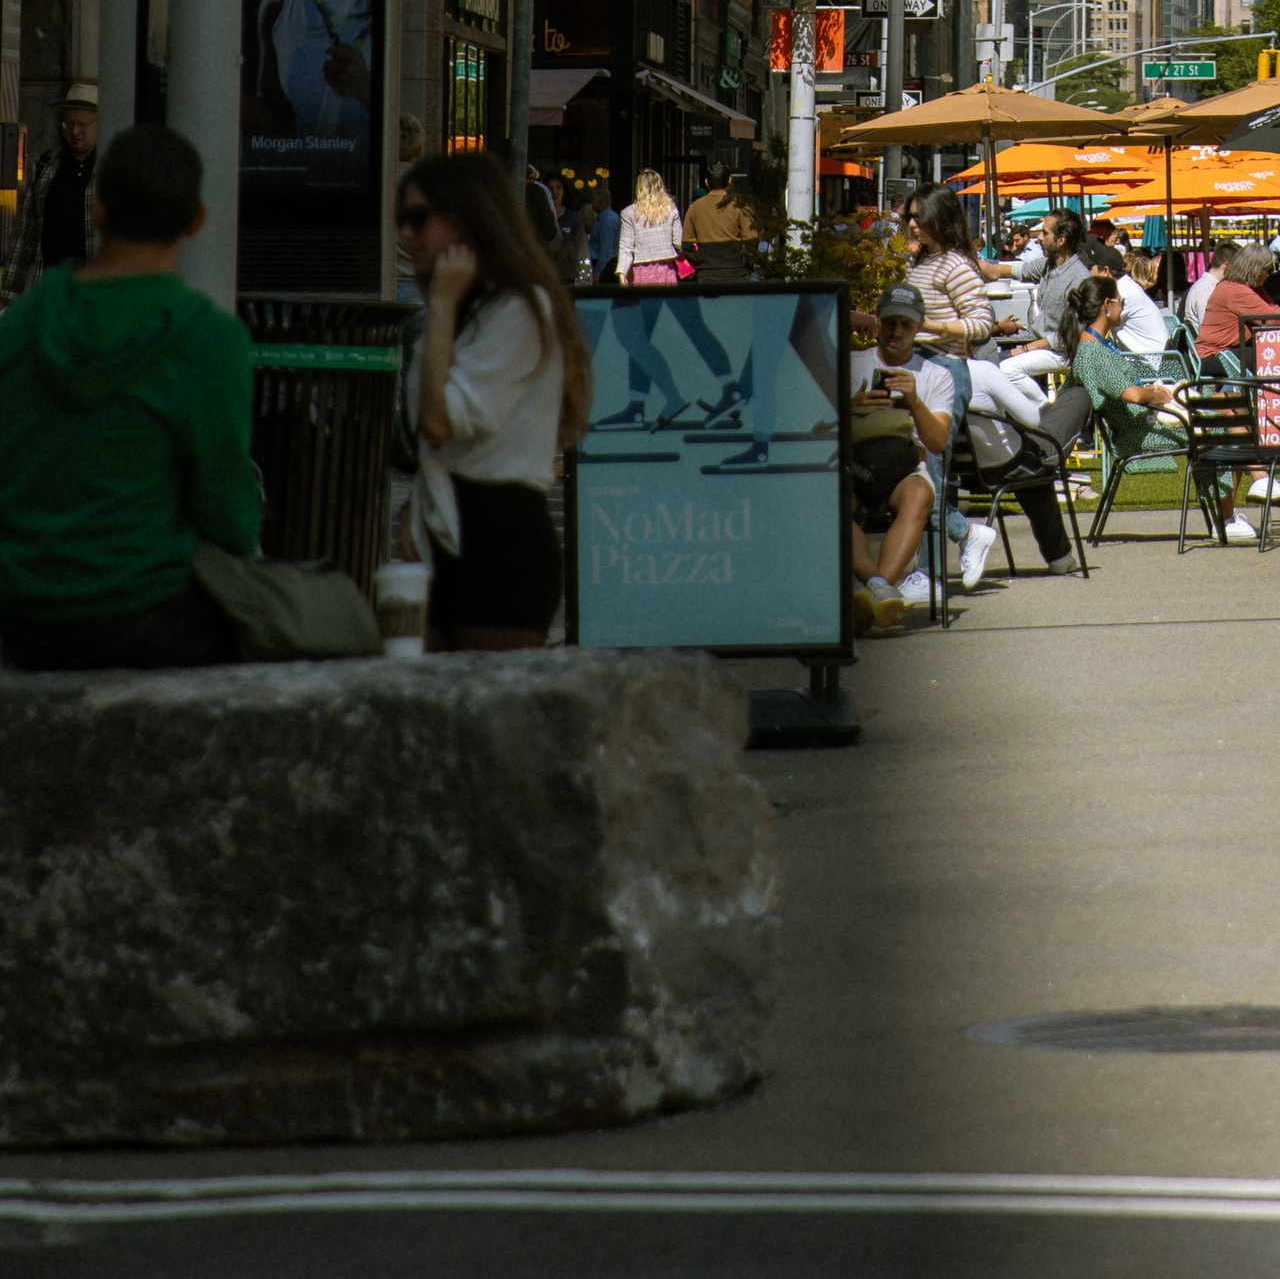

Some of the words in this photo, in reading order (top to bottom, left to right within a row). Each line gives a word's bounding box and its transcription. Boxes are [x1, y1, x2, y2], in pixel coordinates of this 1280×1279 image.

[873, 1, 887, 10] ON
[846, 54, 857, 66] 26
[860, 54, 870, 66] St
[1173, 65, 1184, 76] 27
[1188, 64, 1199, 76] St
[251, 135, 302, 152] Morgan
[305, 135, 357, 151] Stanley
[590, 496, 752, 542] NoMad
[590, 543, 735, 586] Piazza
